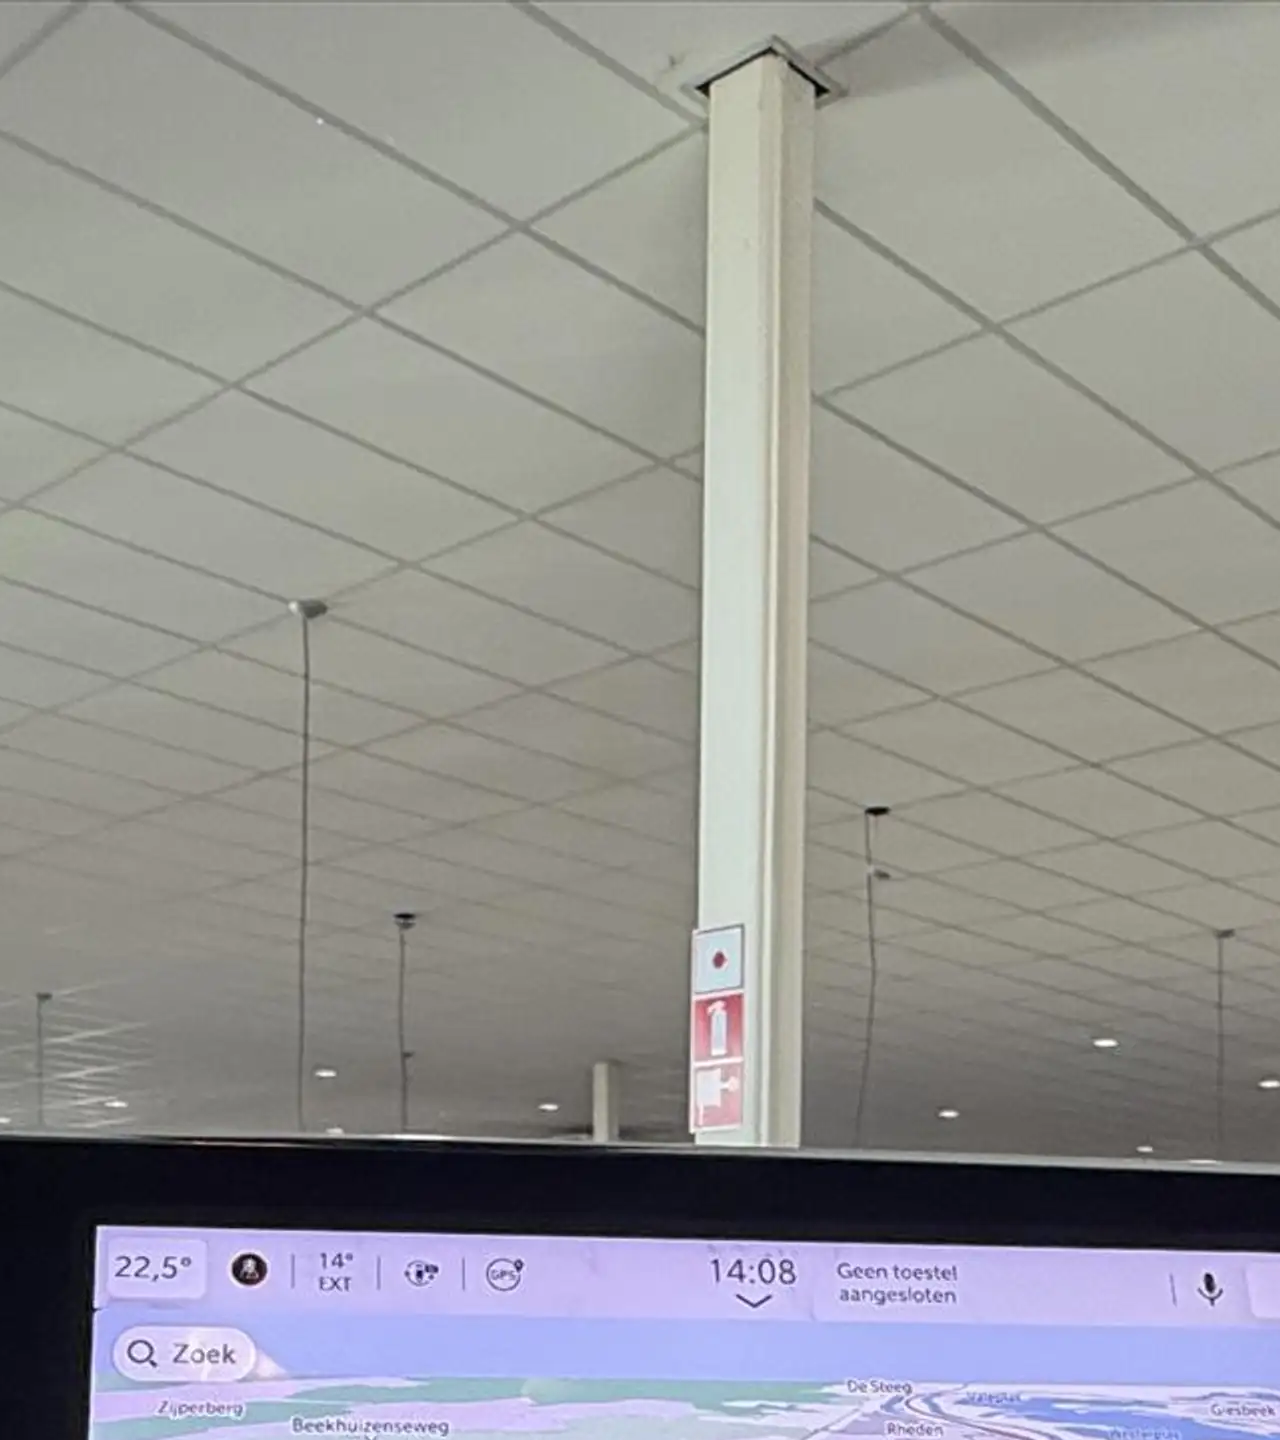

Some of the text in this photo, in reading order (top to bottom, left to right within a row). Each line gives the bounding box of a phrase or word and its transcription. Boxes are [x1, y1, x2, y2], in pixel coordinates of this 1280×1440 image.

[113, 1255, 193, 1283] 22,5°
[709, 1257, 797, 1285] 14:08
[836, 1262, 958, 1282] Geen toestel
[318, 1276, 352, 1292] EXT
[838, 1286, 958, 1305] aangesloten
[172, 1343, 237, 1365] Zoek
[847, 1380, 913, 1395] De Steeg
[157, 1399, 243, 1418] Zijperberg
[291, 1417, 449, 1438] Beekhuizenseweg
